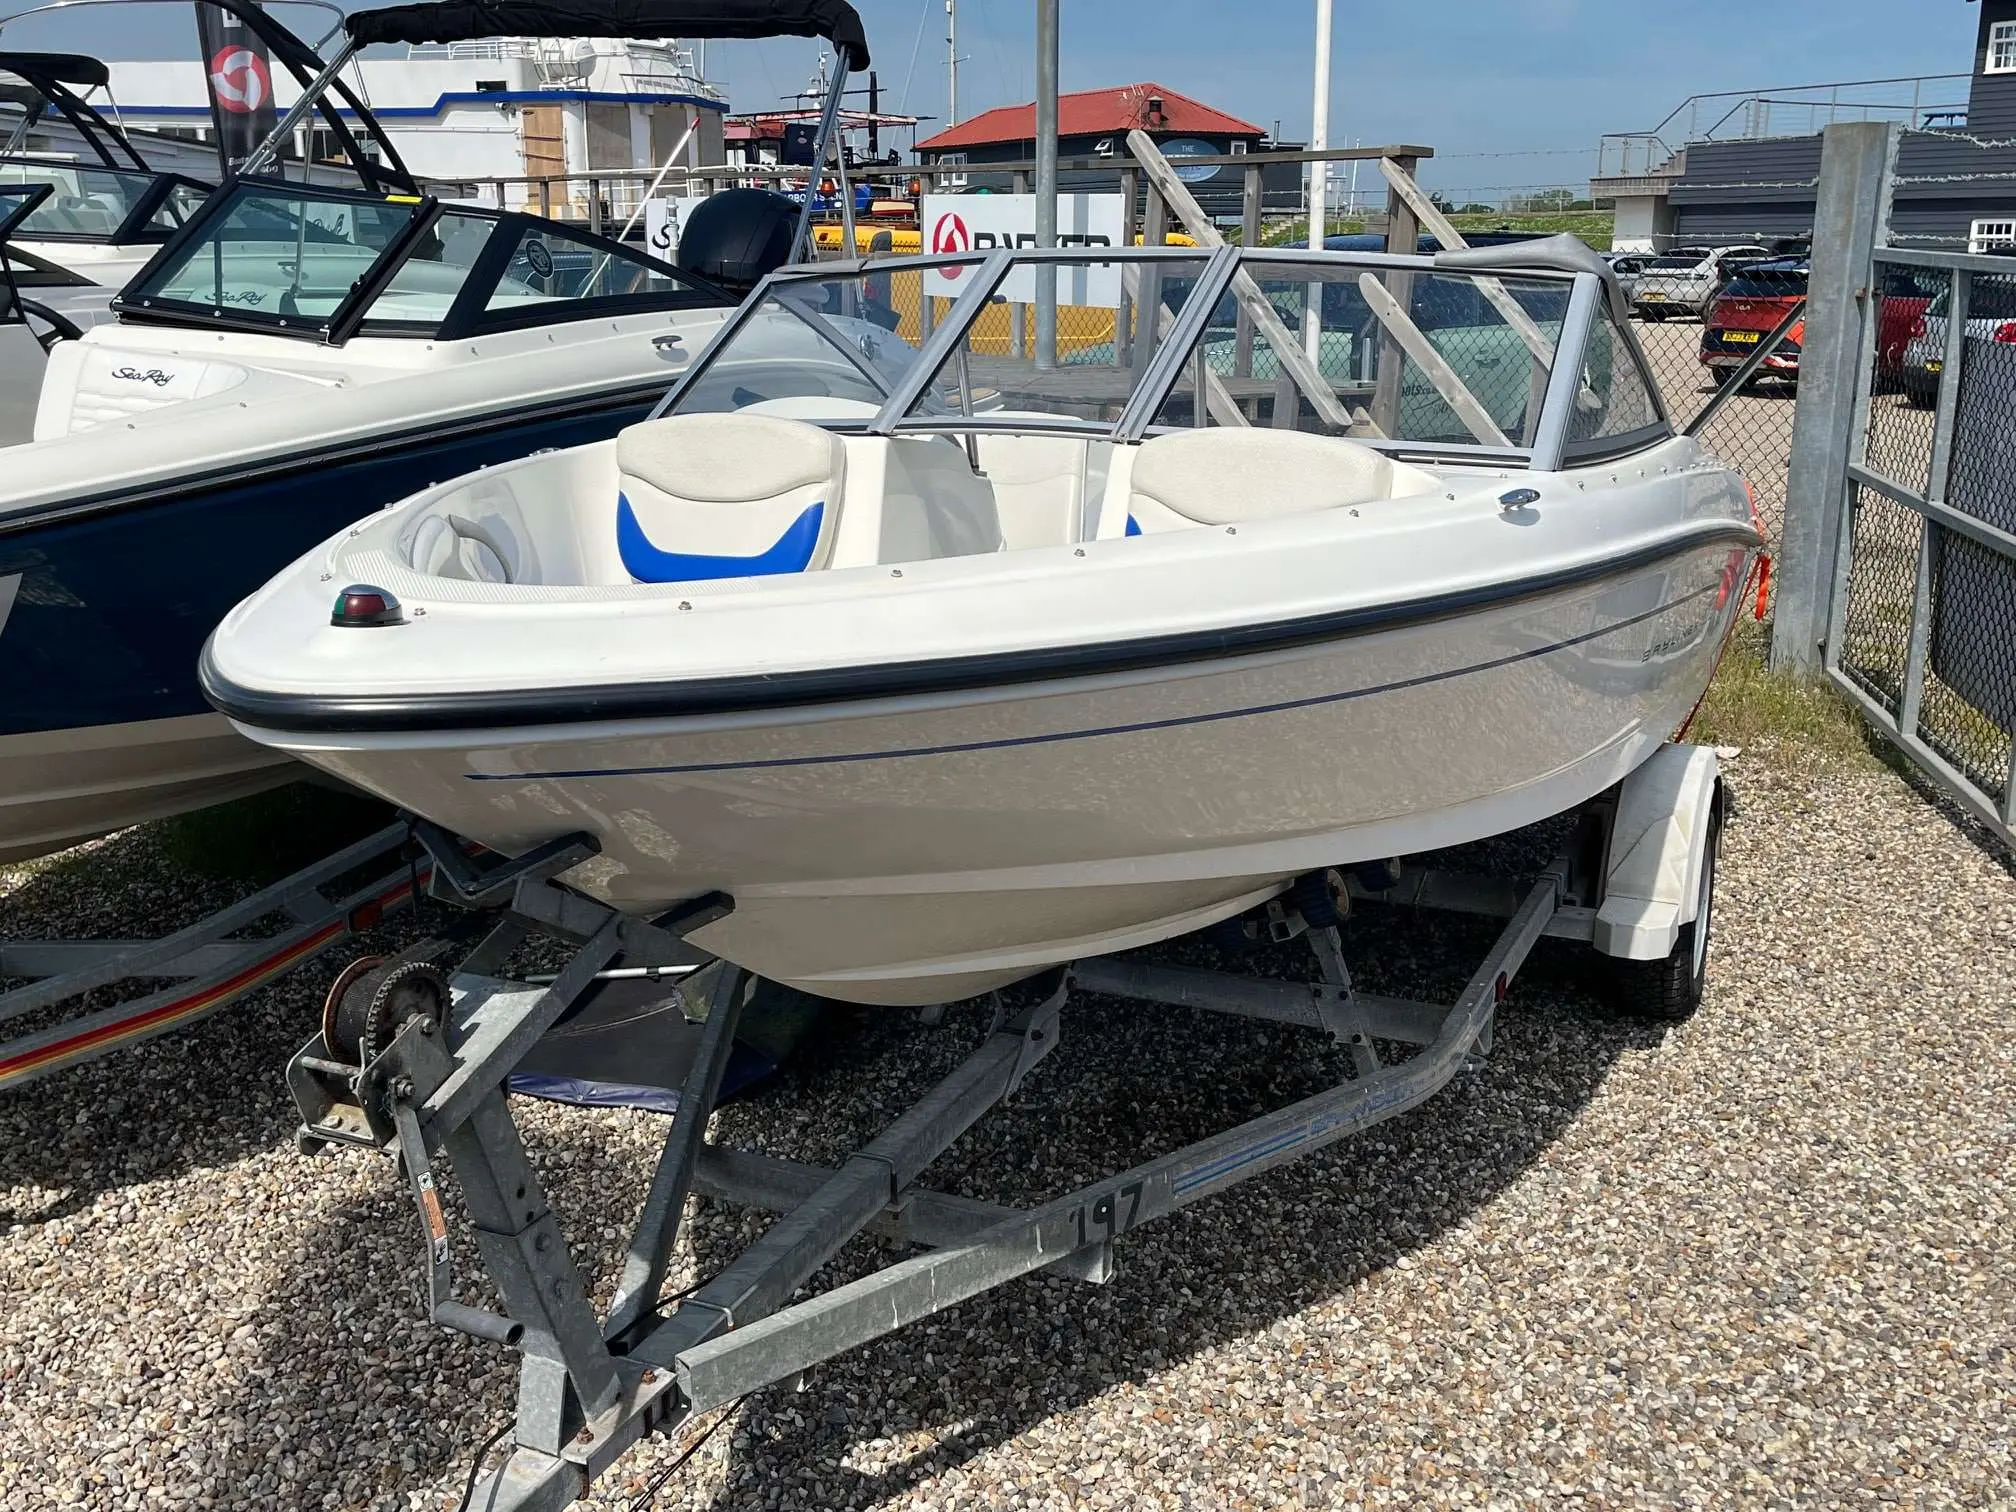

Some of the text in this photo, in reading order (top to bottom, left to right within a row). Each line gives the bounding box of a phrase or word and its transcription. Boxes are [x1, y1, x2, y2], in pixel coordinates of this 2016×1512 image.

[111, 367, 175, 387] Sea Ray
[1068, 1180, 1144, 1247] 197
